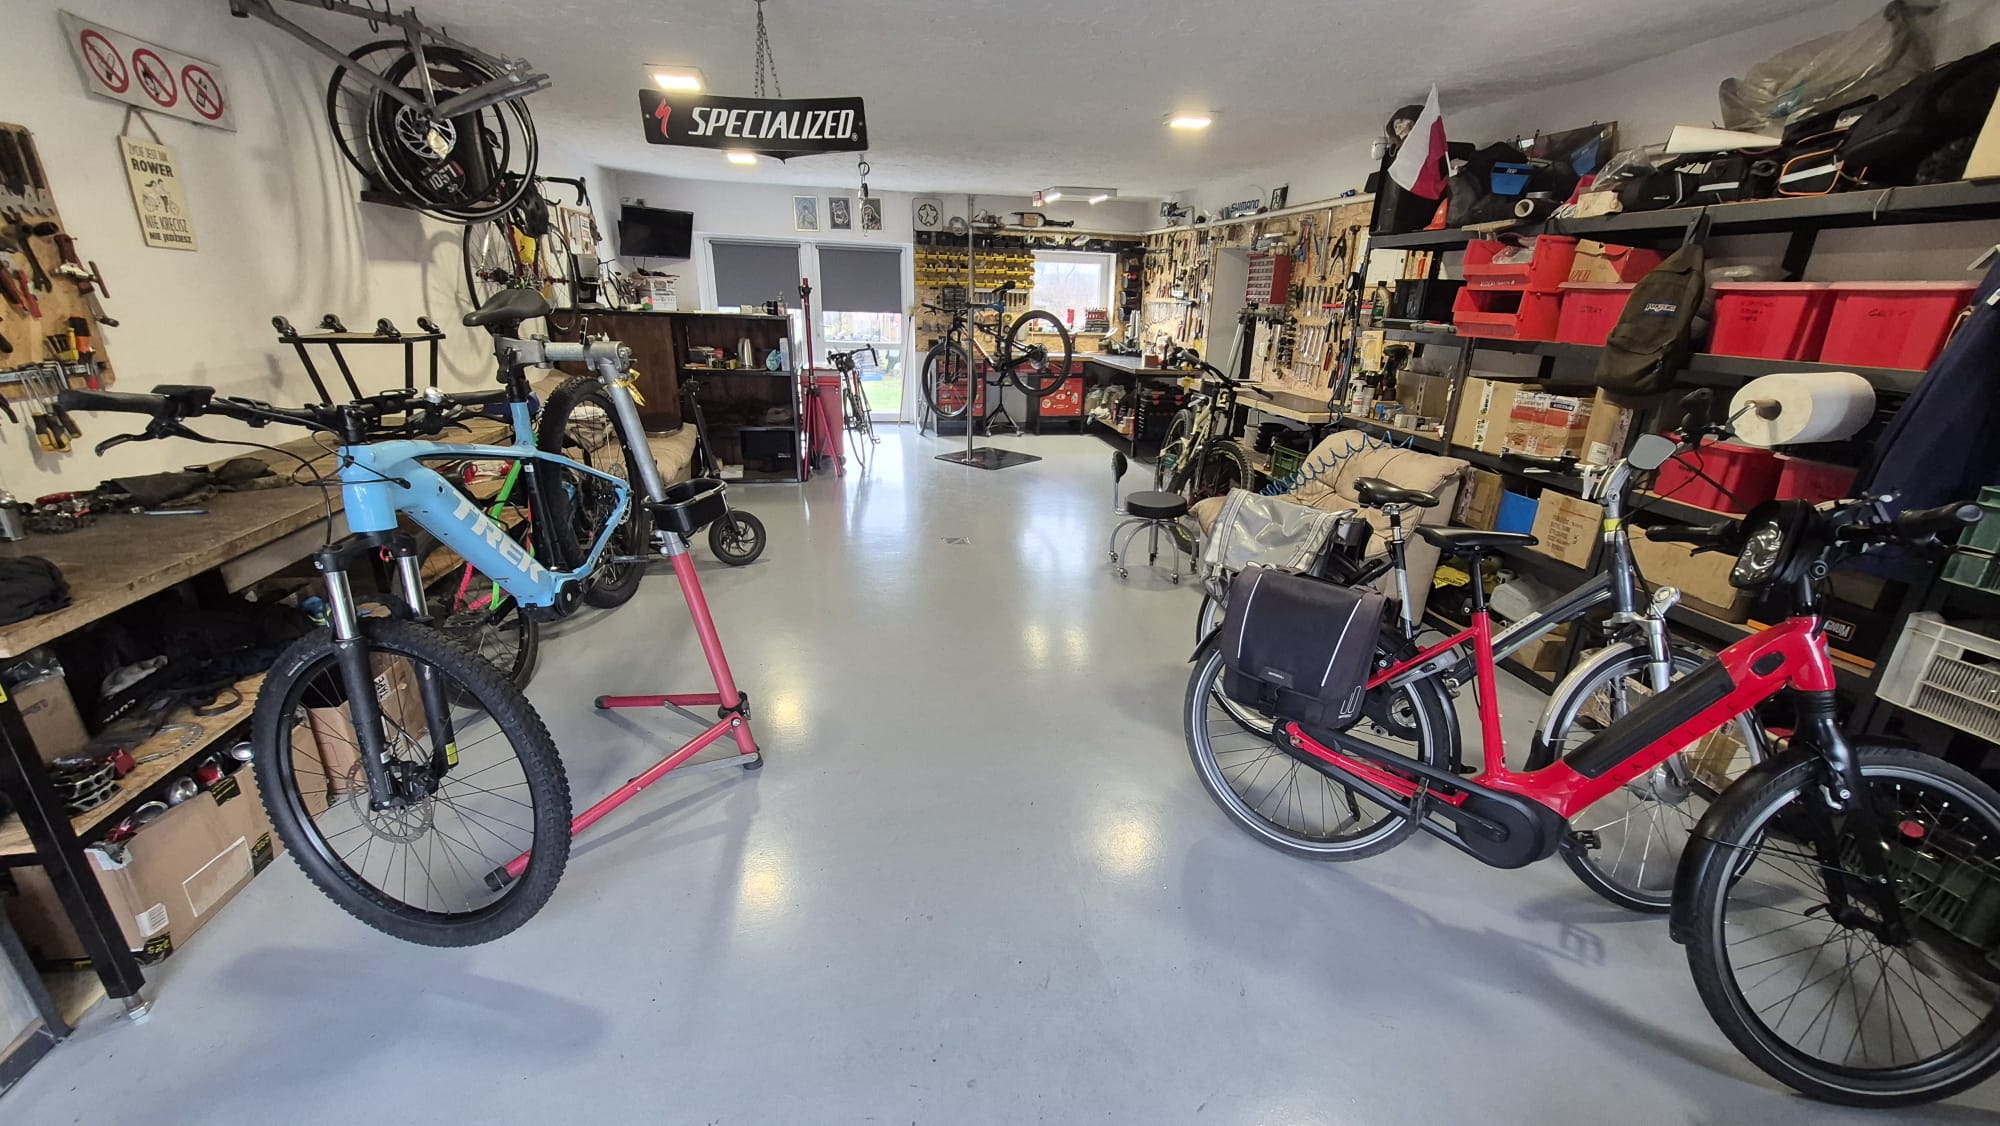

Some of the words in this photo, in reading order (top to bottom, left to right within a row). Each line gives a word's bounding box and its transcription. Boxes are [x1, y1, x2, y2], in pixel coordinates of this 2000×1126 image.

[688, 106, 855, 140] SPECIALIZED
[130, 158, 175, 178] ROWER
[1230, 199, 1260, 213] SHIMANO
[452, 488, 549, 584] TREK
